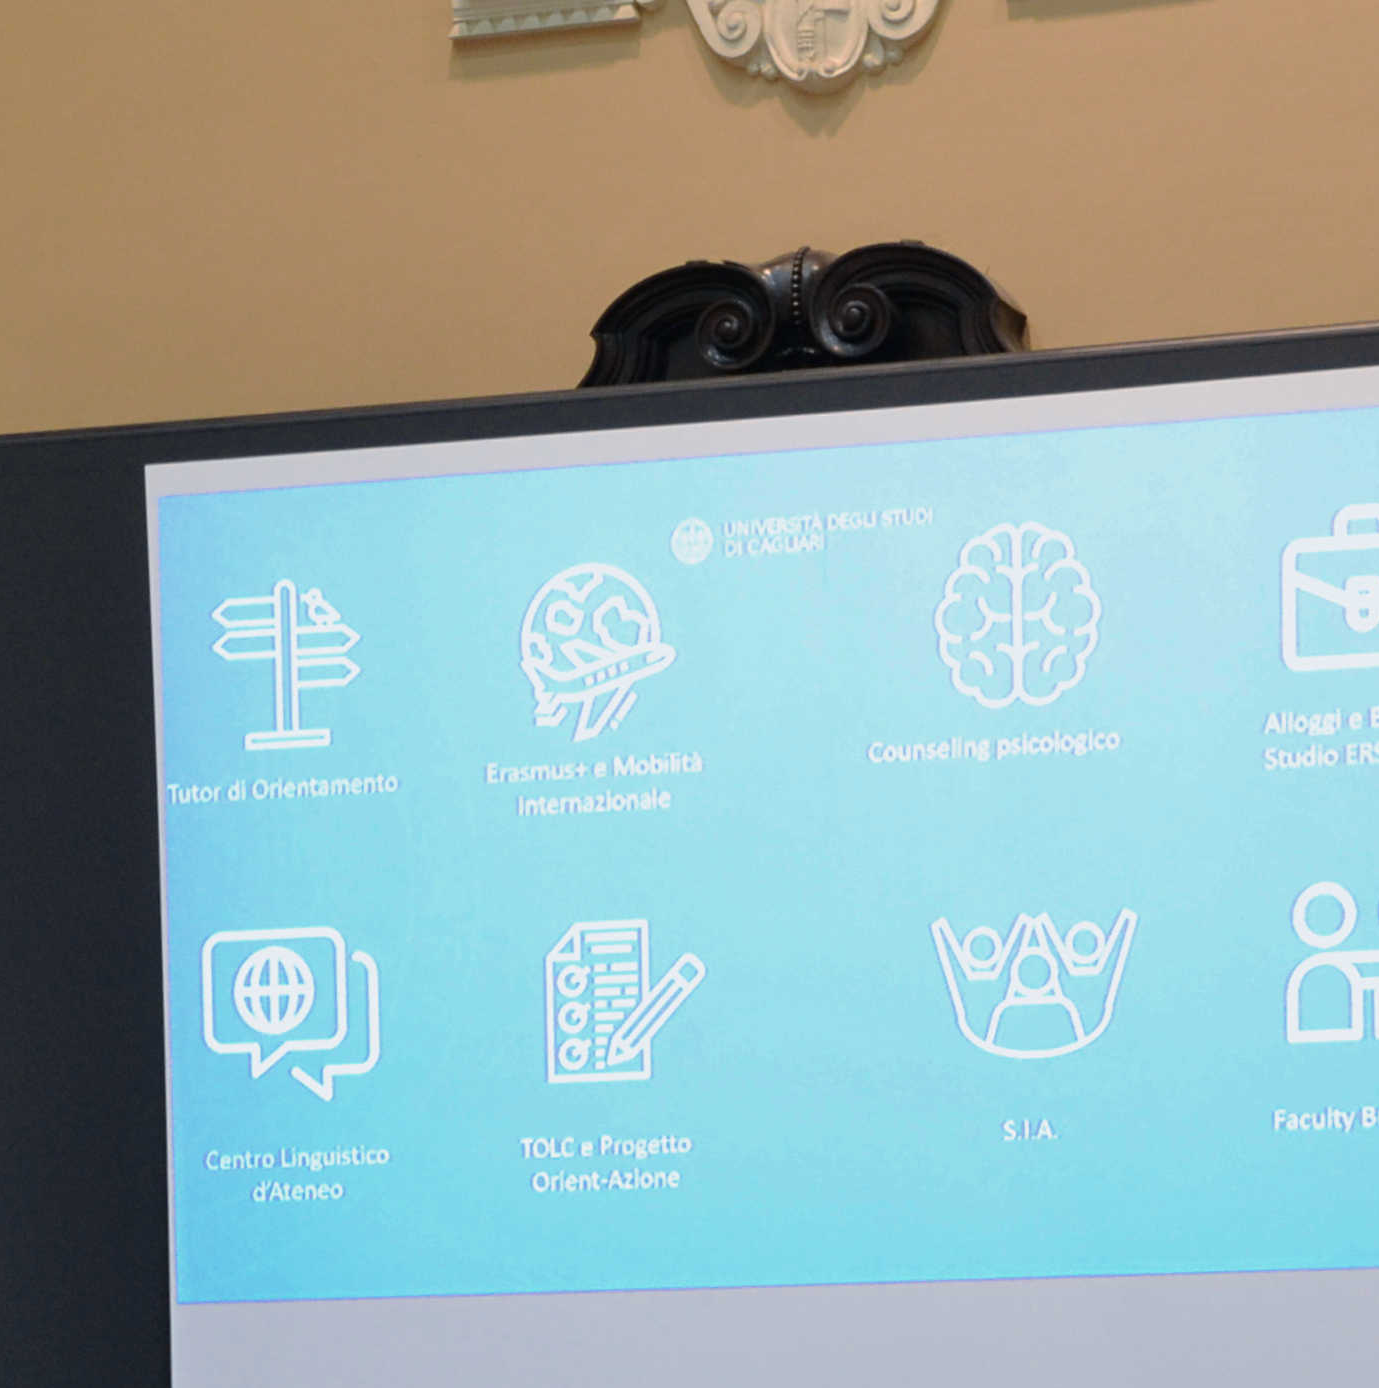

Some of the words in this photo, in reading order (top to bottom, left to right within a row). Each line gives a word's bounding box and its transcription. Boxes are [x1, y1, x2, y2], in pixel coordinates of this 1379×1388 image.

[724, 511, 822, 537] UNIVERSITÀ
[826, 510, 876, 530] DEGLI
[881, 507, 933, 527] STUDI
[725, 540, 742, 557] DI
[746, 534, 824, 556] CAGLIARI
[1263, 708, 1342, 736] Alloggi
[1348, 711, 1363, 730] e
[868, 736, 990, 763] Counseling
[996, 729, 1121, 760] psicologico
[1263, 743, 1339, 771] Studio
[486, 762, 588, 784] Erasmus+
[593, 761, 607, 778] e
[613, 752, 703, 777] Mobilità
[167, 783, 221, 804] Tutor
[227, 780, 246, 801] di
[252, 775, 399, 800] Orientamento
[518, 787, 672, 816] Internazionale
[1003, 1119, 1058, 1141] S.I.A.
[1273, 1106, 1356, 1133] Faculty
[205, 1149, 275, 1171] Centro
[280, 1145, 390, 1171] Linguistico
[520, 1136, 575, 1160] TOLC
[580, 1141, 593, 1157] e
[600, 1134, 692, 1160] Progetto
[532, 1167, 681, 1193] Orient-Azione
